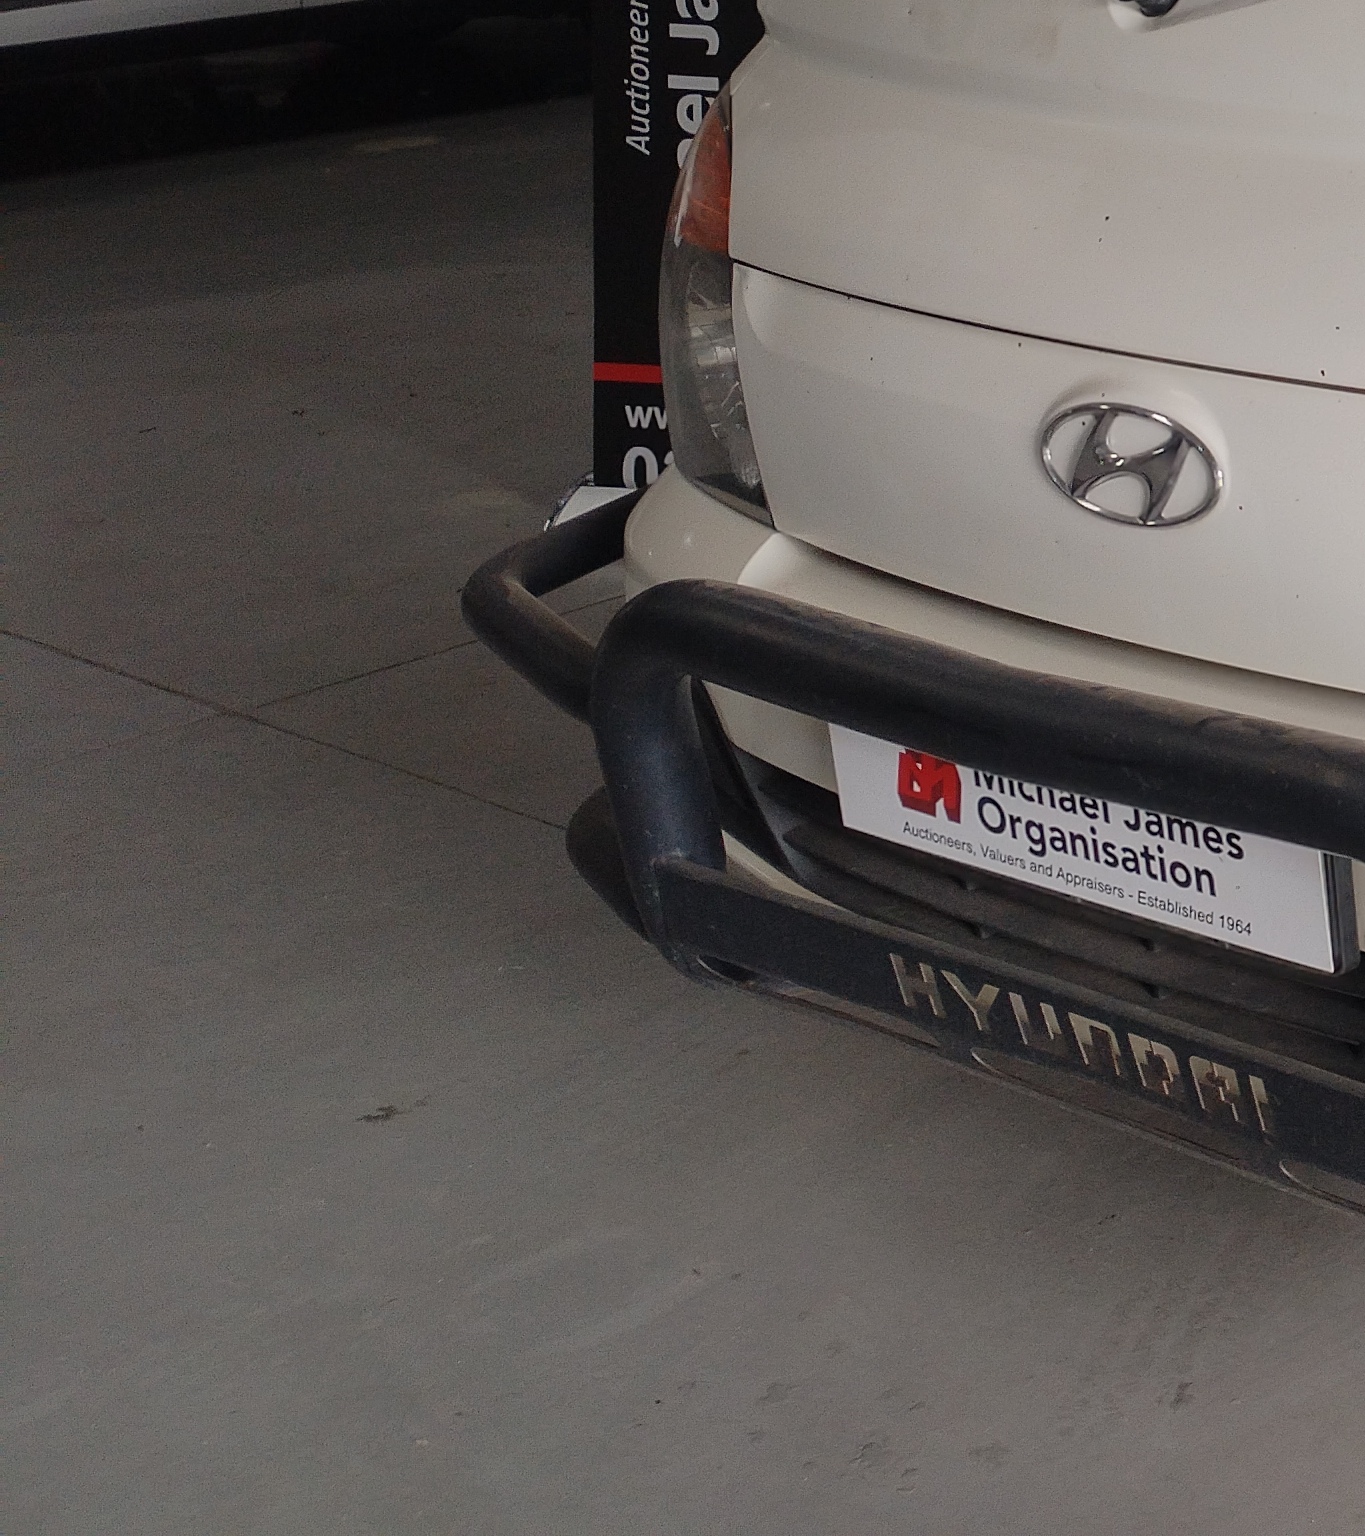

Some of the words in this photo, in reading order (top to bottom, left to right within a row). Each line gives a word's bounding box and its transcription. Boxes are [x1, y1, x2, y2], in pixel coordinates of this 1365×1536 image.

[902, 821, 977, 856] Auctioneers,
[980, 843, 1026, 870] Valuers
[1029, 861, 1053, 877] and
[1056, 866, 1125, 899] Appraisers
[1137, 890, 1214, 925] Established
[1218, 915, 1252, 937] 1964
[976, 796, 1217, 898] Organisation
